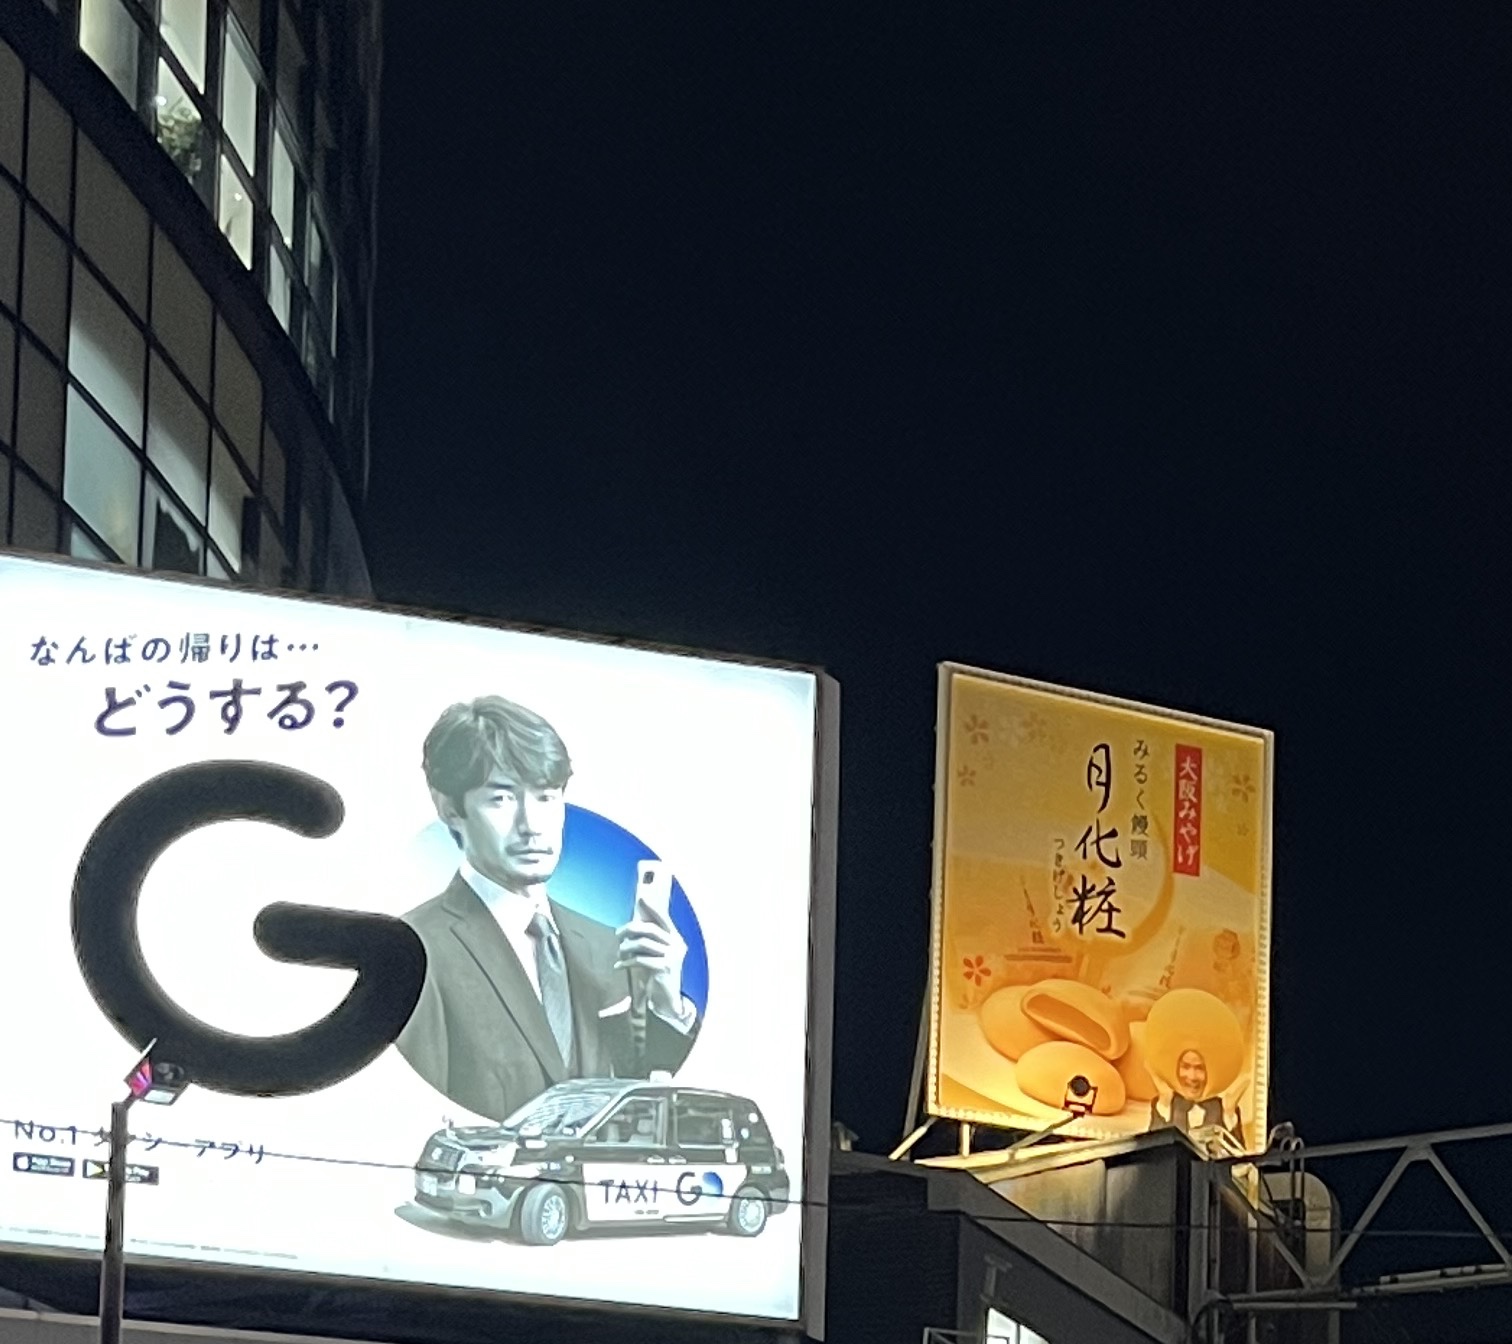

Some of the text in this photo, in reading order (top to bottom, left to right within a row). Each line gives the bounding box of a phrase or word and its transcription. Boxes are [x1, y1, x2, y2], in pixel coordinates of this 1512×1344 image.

[1067, 742, 1127, 939] 月化粧
[1178, 755, 1198, 868] 大阪みやげ
[598, 1178, 659, 1204] TAXI
